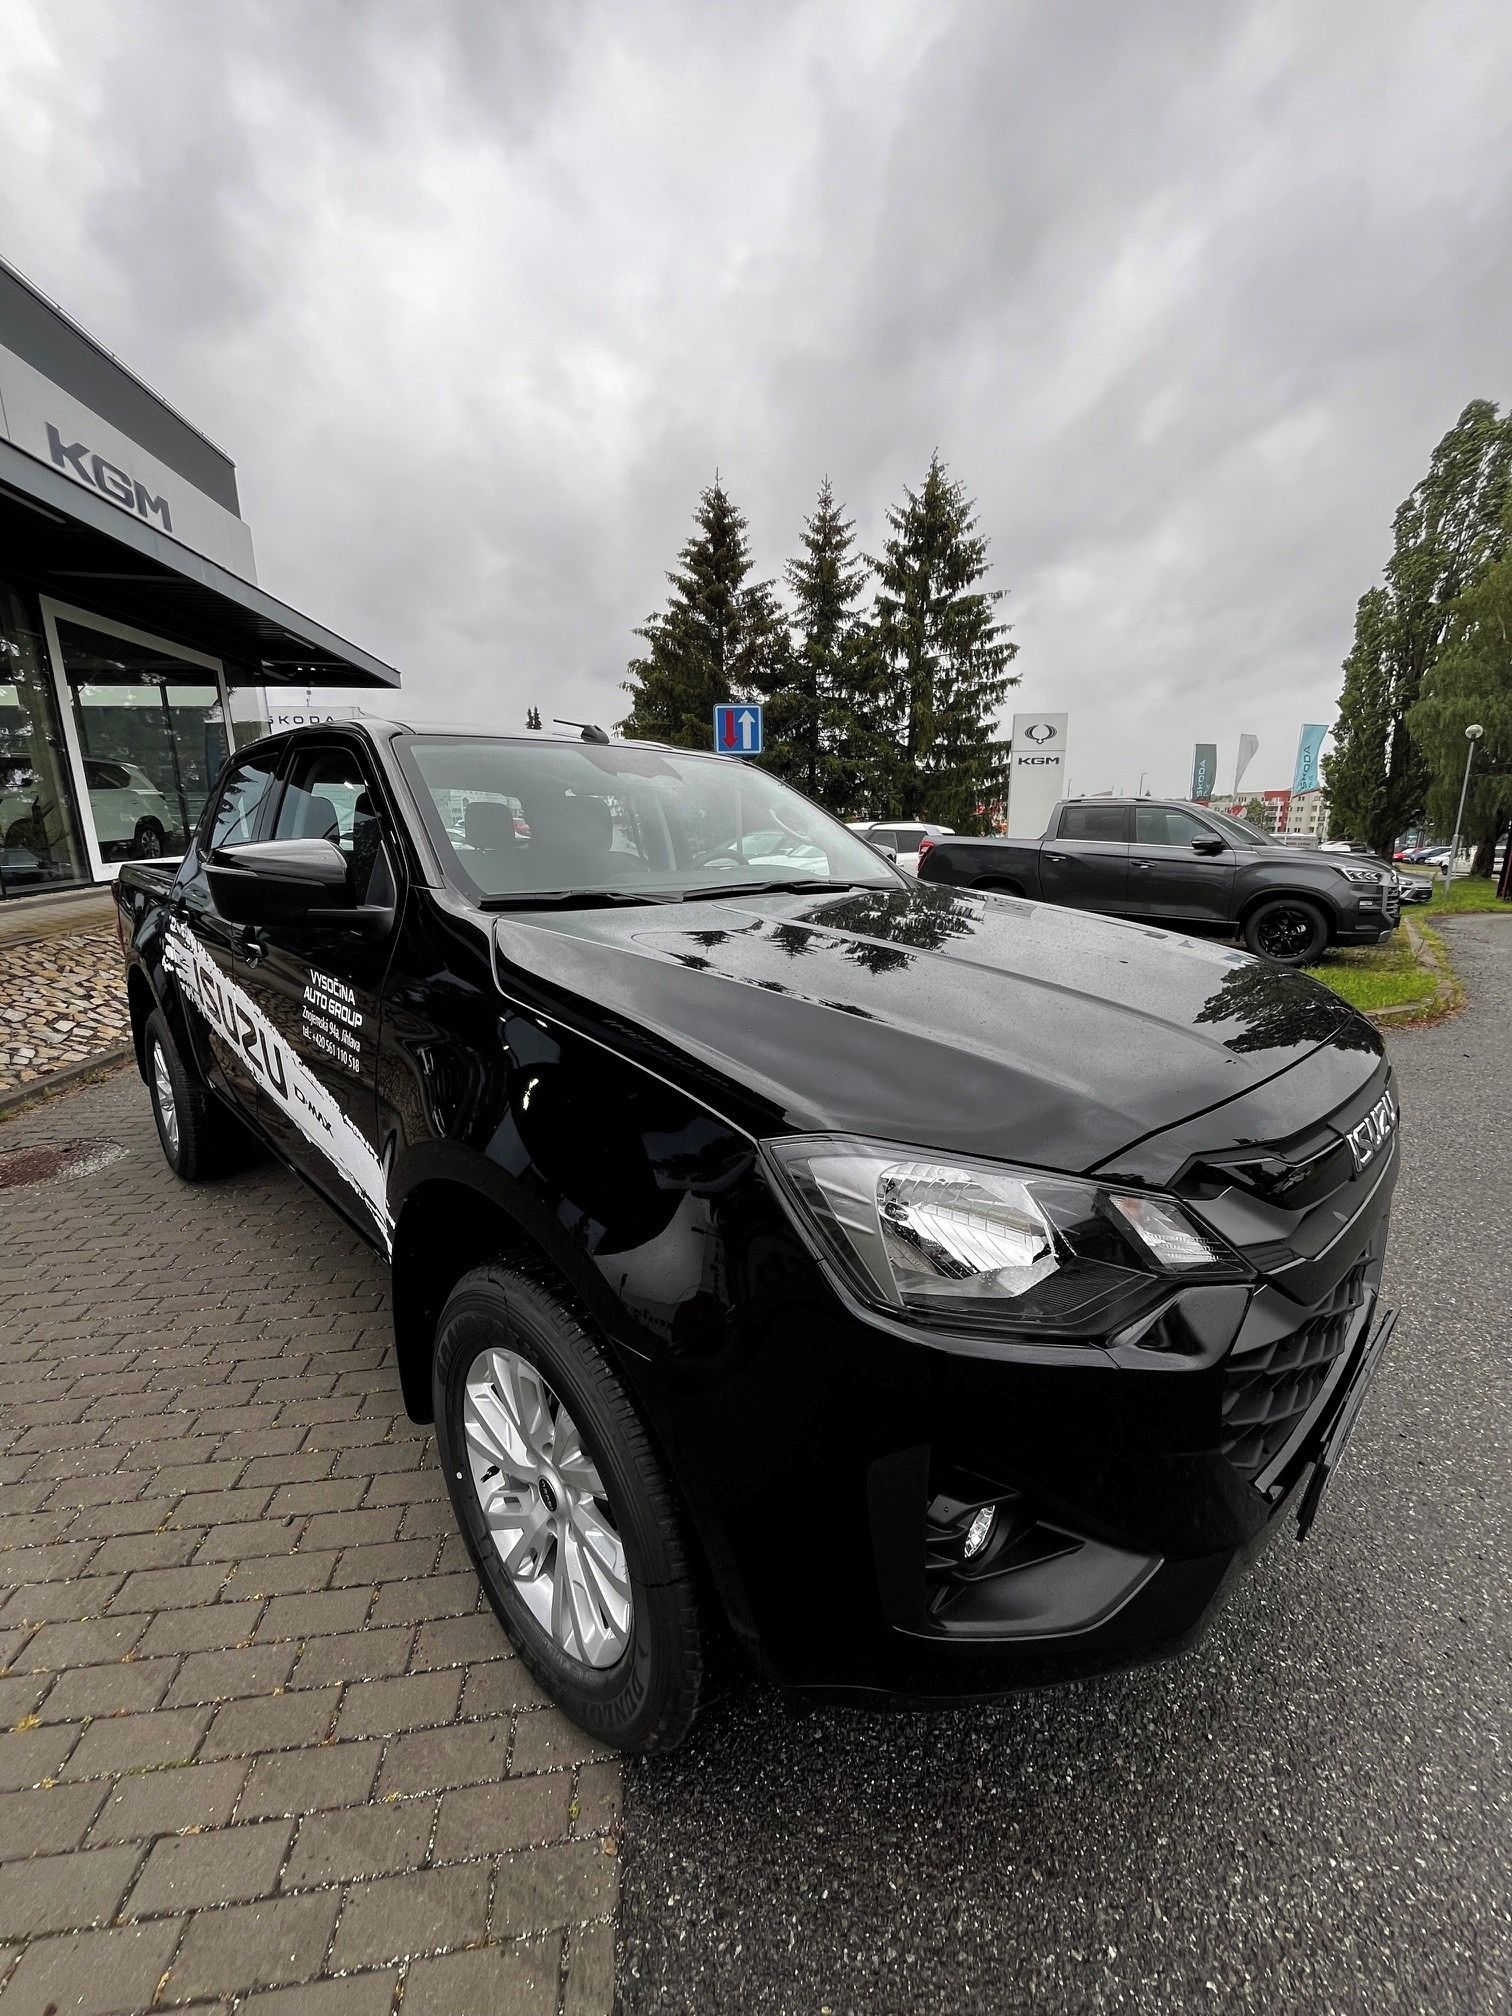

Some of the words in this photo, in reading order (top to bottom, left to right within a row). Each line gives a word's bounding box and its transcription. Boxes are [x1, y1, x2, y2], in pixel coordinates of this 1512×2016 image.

[45, 421, 173, 533] KGM
[1018, 757, 1060, 765] KGM
[303, 985, 328, 1010] AUTO
[328, 998, 363, 1028] GROUP
[310, 968, 356, 1006] VYSOČINA
[193, 958, 289, 1100] ISUZU
[302, 1005, 329, 1032] Znojemská
[340, 1029, 361, 1053] Jihlava
[312, 1033, 326, 1049] +420
[325, 1040, 336, 1056] 561
[336, 1047, 348, 1065] 110
[348, 1054, 360, 1073] 518
[1345, 1090, 1397, 1172] ISUZU
